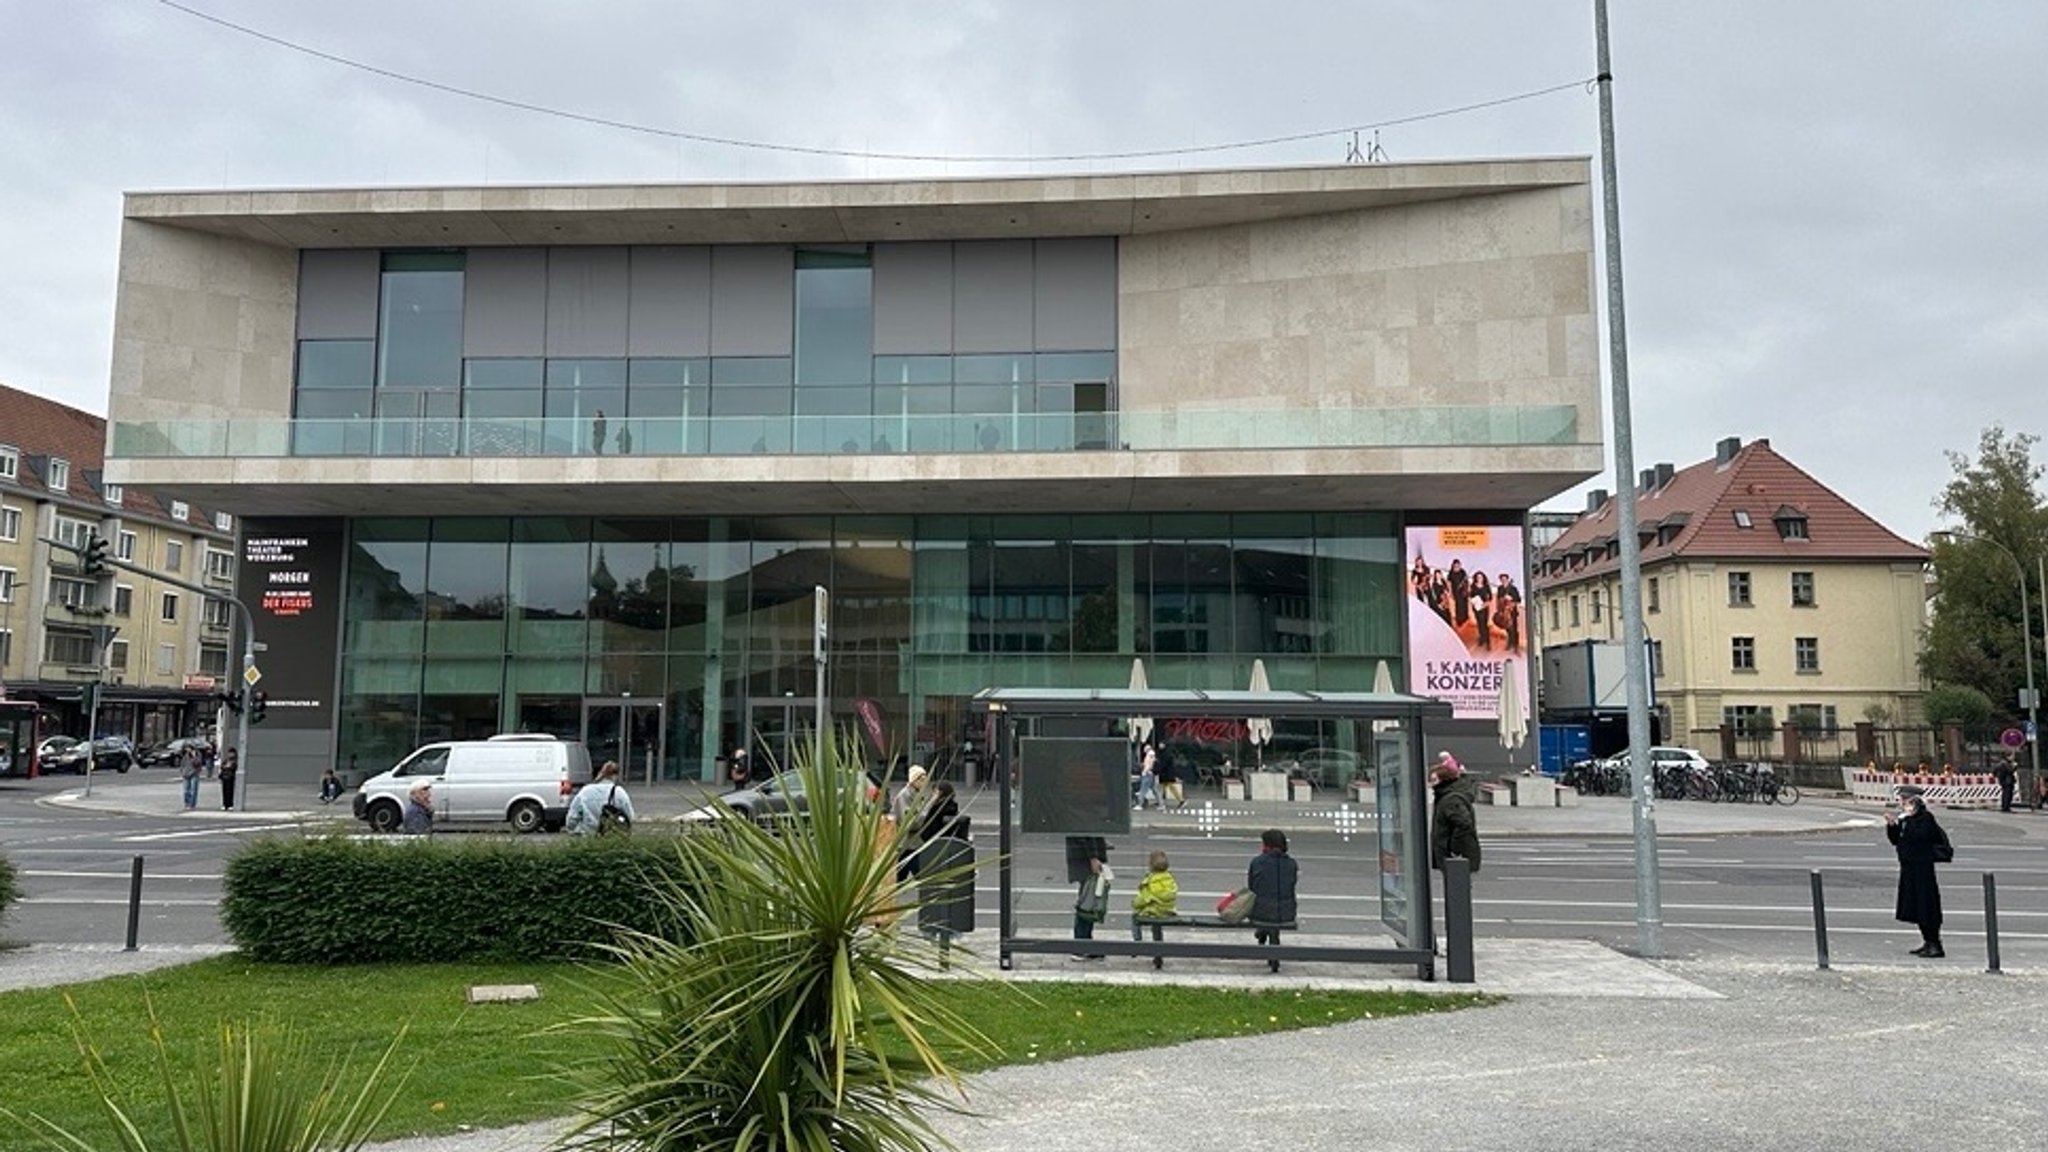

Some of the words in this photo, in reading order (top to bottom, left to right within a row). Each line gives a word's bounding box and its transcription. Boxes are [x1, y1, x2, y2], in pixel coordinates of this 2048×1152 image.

[247, 546, 282, 554] THEATER
[268, 571, 310, 583] MORGEN
[262, 597, 279, 608] DER
[1425, 661, 1437, 674] 1.
[1440, 661, 1502, 675] KAMME
[1427, 675, 1503, 690] KONZER
